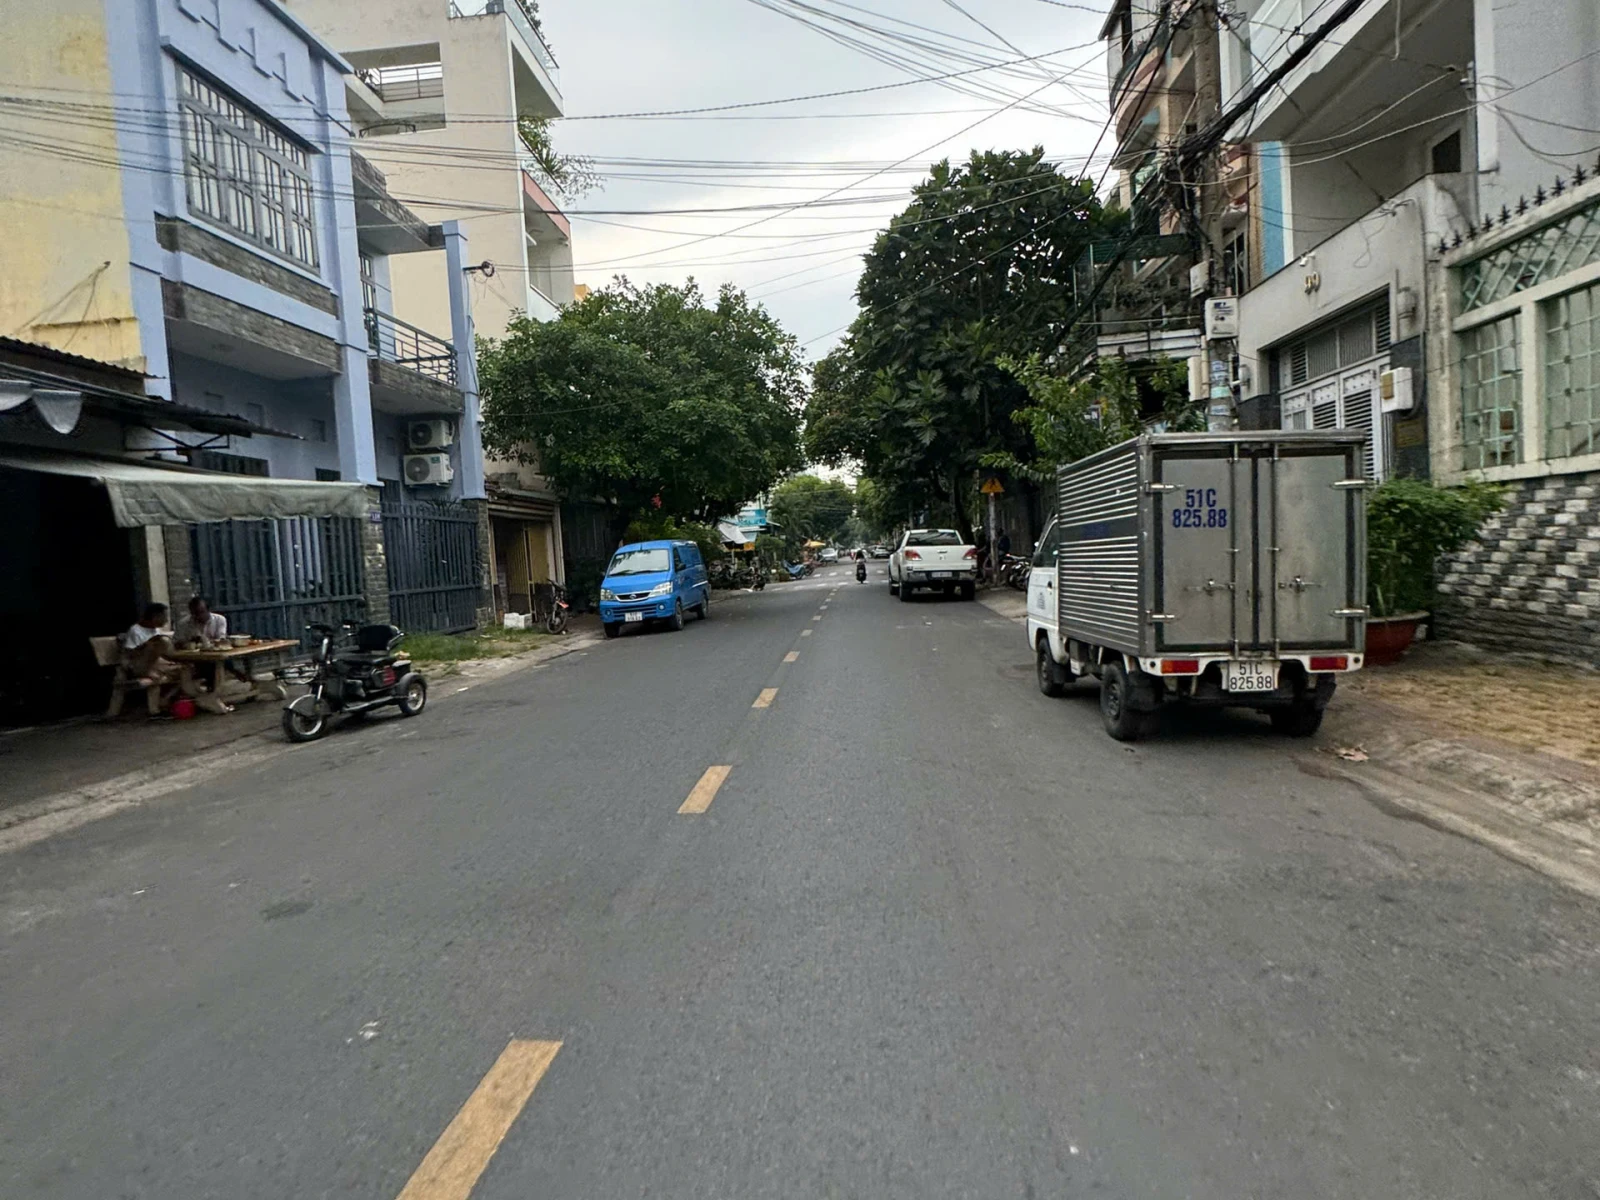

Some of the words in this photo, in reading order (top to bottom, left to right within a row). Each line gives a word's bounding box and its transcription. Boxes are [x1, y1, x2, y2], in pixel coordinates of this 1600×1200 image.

[1185, 488, 1216, 508] 51C
[1172, 508, 1227, 528] 825.88
[1239, 660, 1263, 676] 51C
[1230, 675, 1272, 690] 825.88
